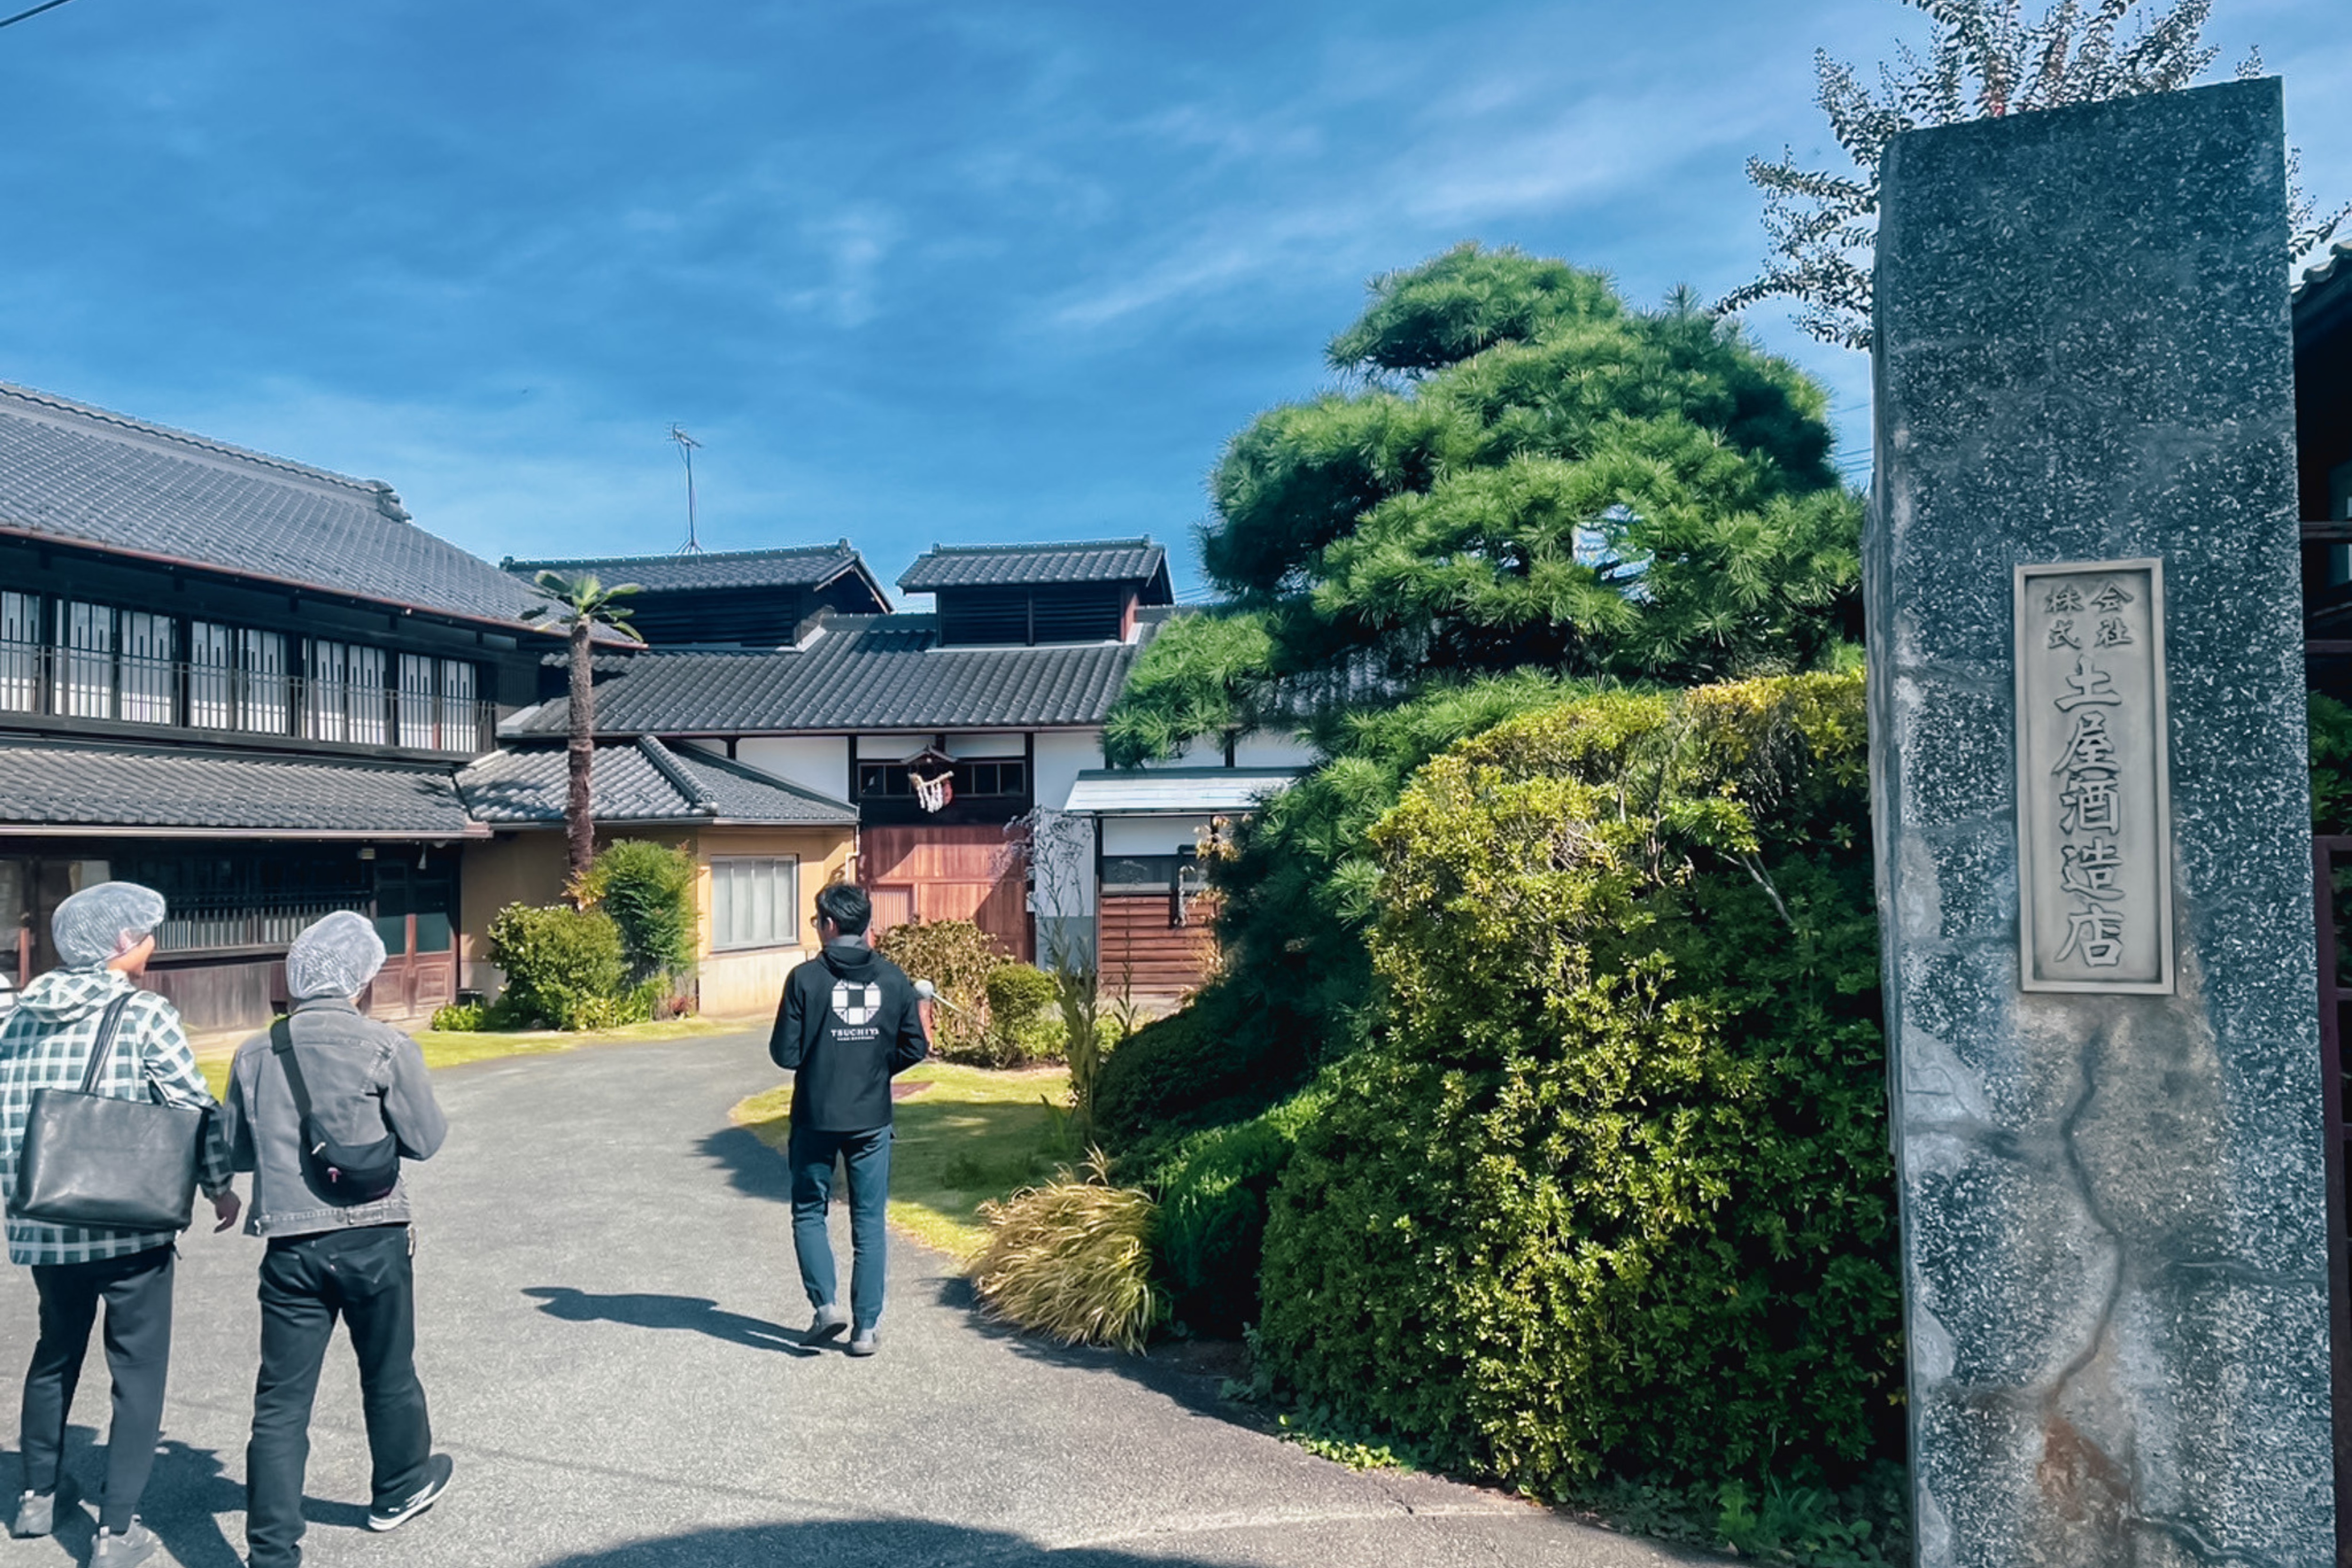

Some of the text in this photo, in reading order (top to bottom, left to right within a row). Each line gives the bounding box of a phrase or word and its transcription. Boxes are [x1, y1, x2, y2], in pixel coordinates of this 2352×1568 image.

[2051, 653, 2124, 967] 土屋酒造店
